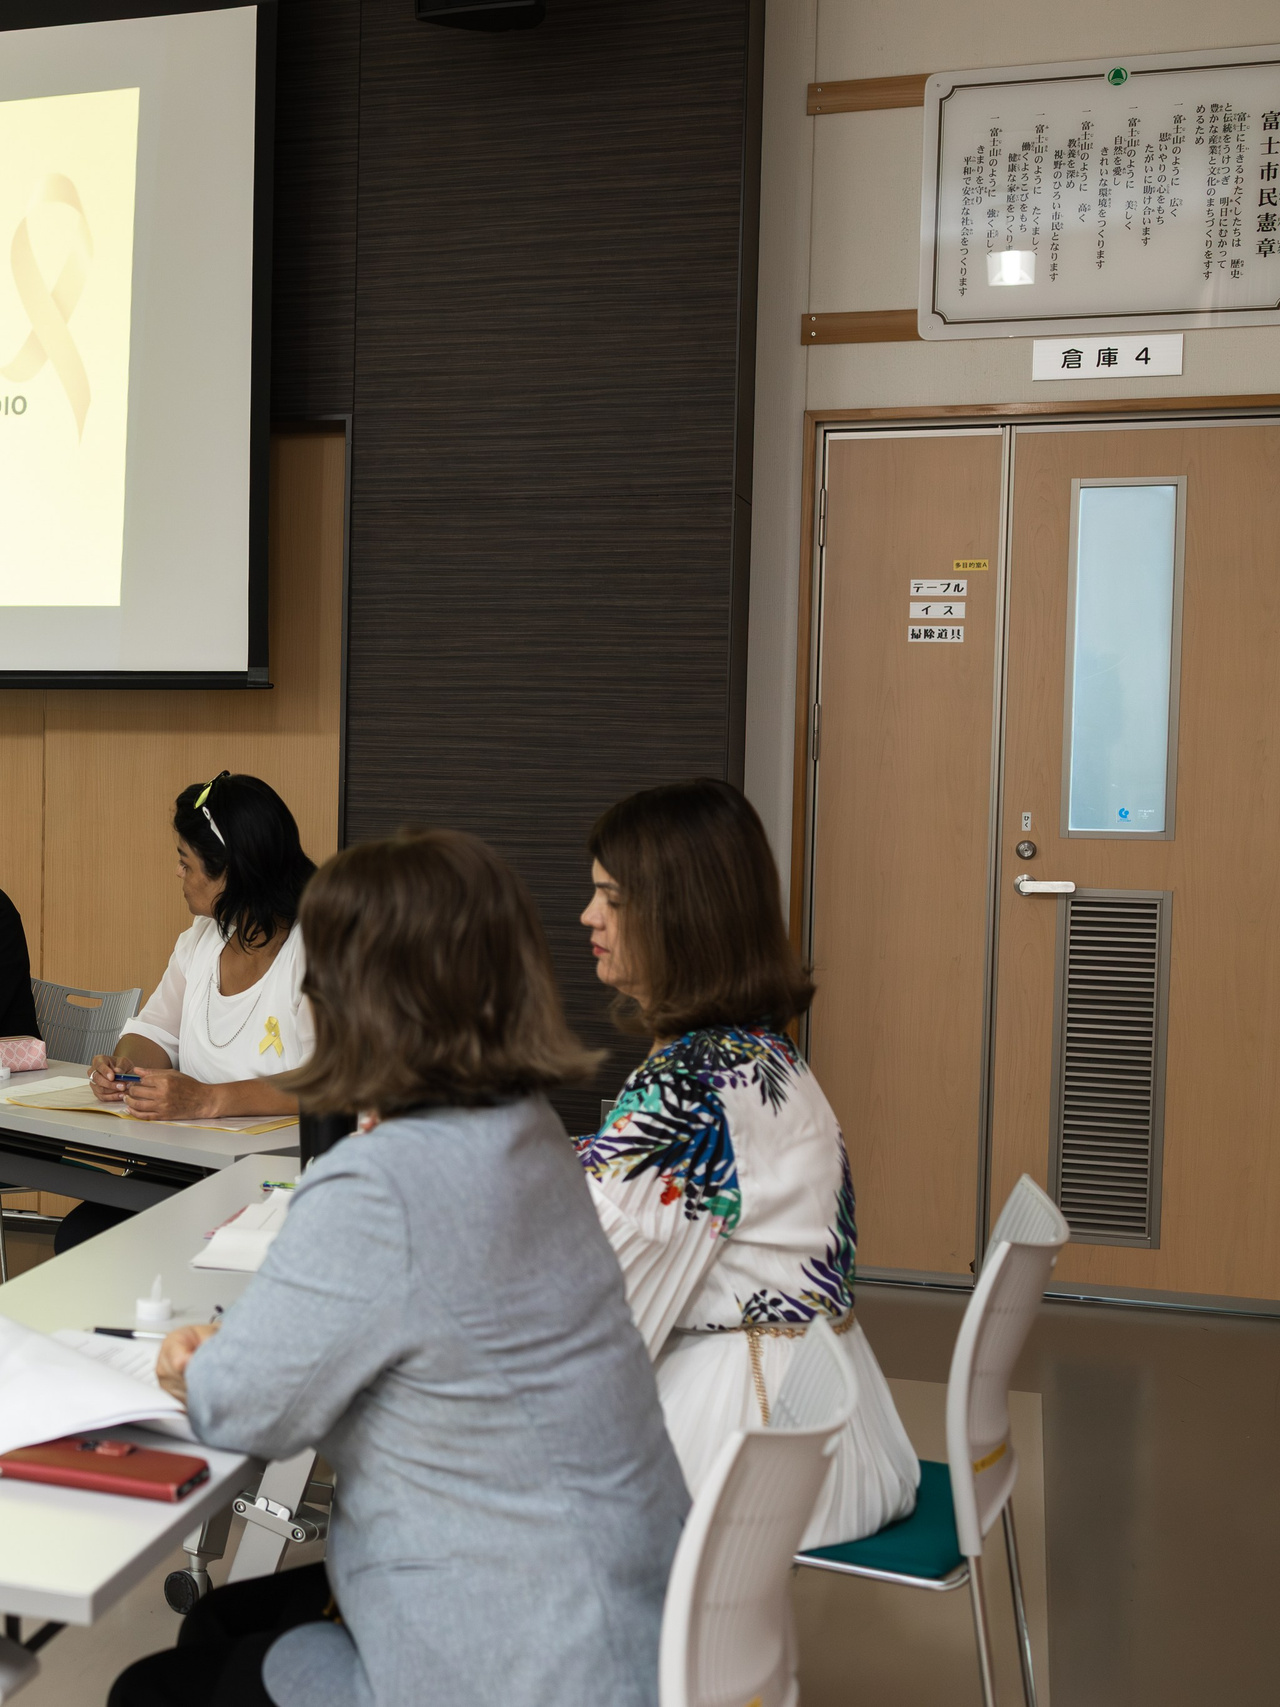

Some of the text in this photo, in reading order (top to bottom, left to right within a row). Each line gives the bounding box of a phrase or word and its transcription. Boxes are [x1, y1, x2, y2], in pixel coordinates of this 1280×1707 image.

[1033, 124, 1045, 195] 富士山のように
[1078, 121, 1092, 192] 富士山のように
[1112, 134, 1123, 186] 自然を愛し
[1126, 118, 1138, 189] 富士山のように
[1170, 114, 1183, 186] 富士山のように
[1194, 104, 1206, 146] めるため
[974, 145, 985, 206] きまりを守り
[987, 128, 1000, 198] 富士山のように
[1019, 142, 1031, 233] 働くよろこびをもち
[1066, 138, 1077, 189] 教養を深め
[1141, 144, 1154, 246] たがいに助け合います
[1156, 132, 1170, 226] 思いやりの心をもち
[1203, 103, 1219, 280] 豊かな産業と文化のまちづくりをすす
[1230, 112, 1247, 280] 富士に生きるわたくしたちは 歴史
[1256, 110, 1280, 258] 富士市民憲章
[958, 156, 972, 296] 平和で安全な社会をつくります
[1032, 206, 1041, 256] たくましく
[1049, 150, 1064, 282] 視野のひろい市民となります
[1078, 202, 1088, 223] 高く
[1096, 146, 1109, 270] きれいな環境をつくります
[1124, 200, 1134, 230] 美しく
[1170, 198, 1180, 218] 広く
[1218, 196, 1230, 268] 明日にむかって
[912, 582, 964, 593] テーブル
[910, 628, 961, 640] 掃除道具
[1024, 816, 1030, 828] ひく
